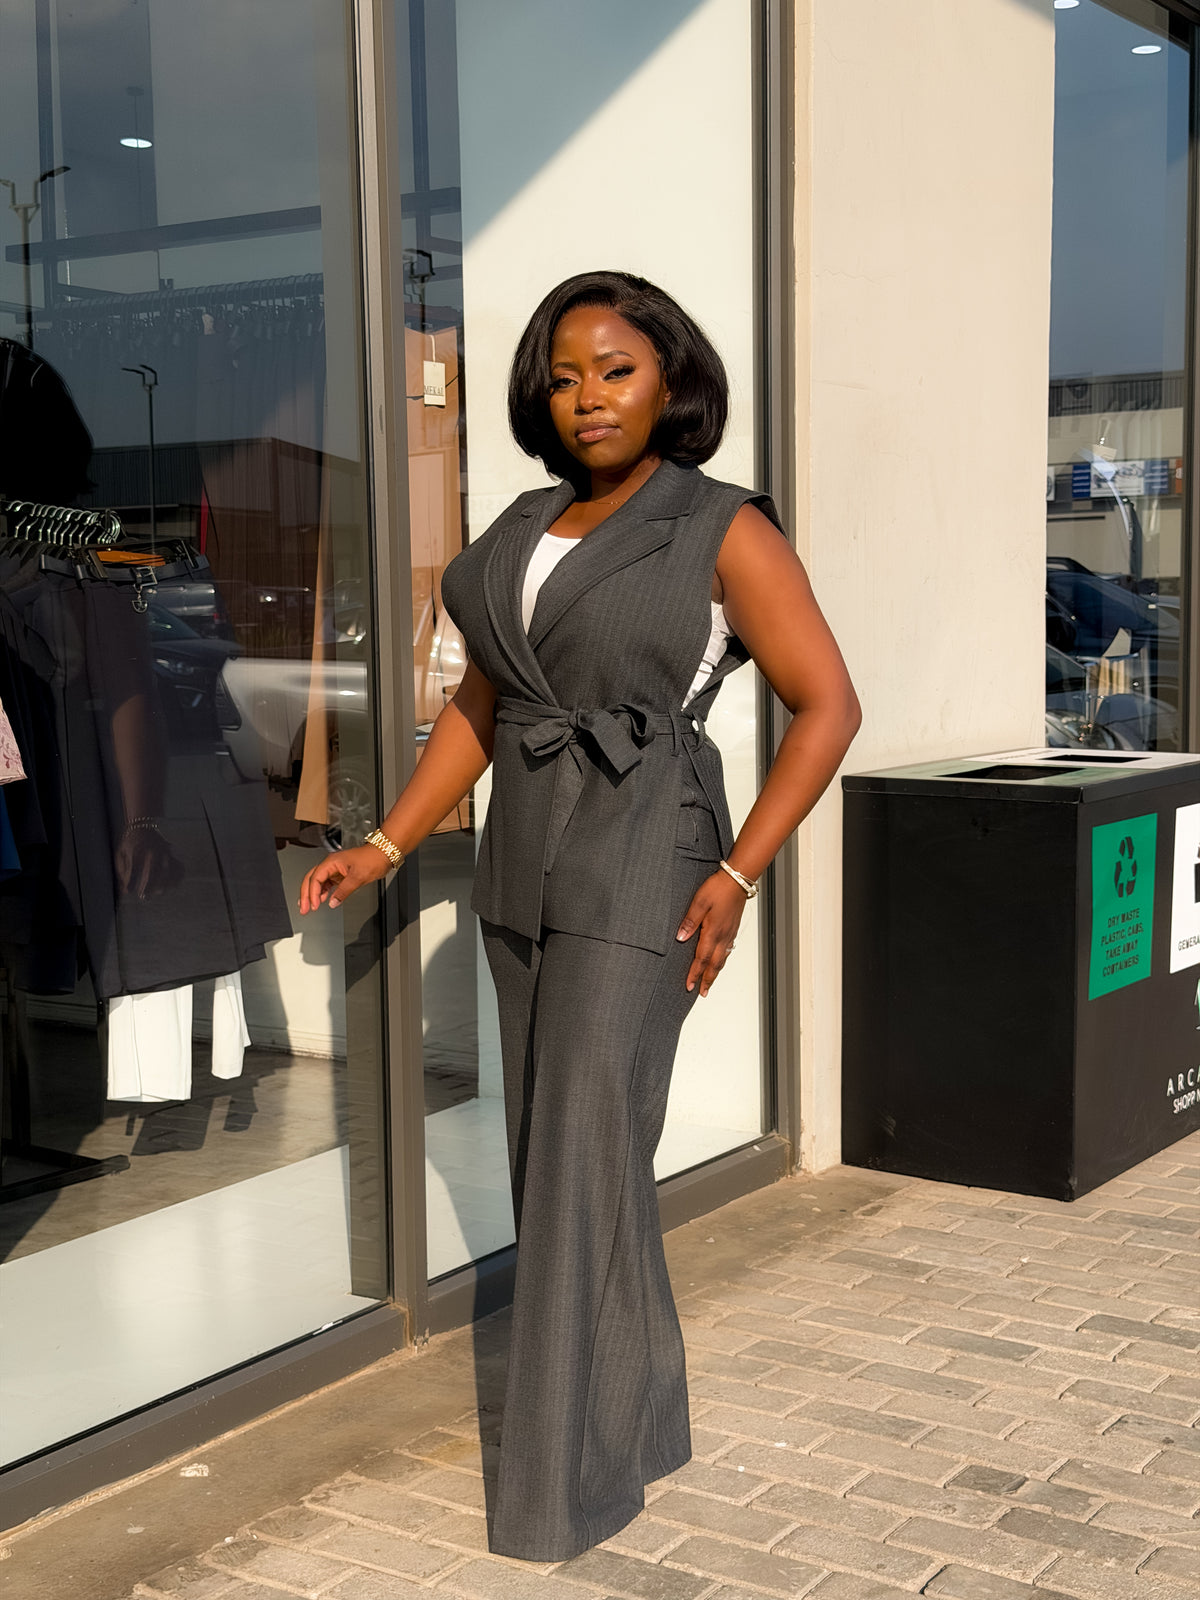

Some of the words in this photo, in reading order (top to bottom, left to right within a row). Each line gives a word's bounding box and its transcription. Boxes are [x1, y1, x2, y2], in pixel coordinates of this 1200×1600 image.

[1107, 914, 1119, 929] DRY
[1120, 908, 1140, 924] WASTE
[1105, 945, 1120, 959] TAKE
[1122, 939, 1138, 954] AWAY
[1103, 954, 1139, 977] CONTAINERS
